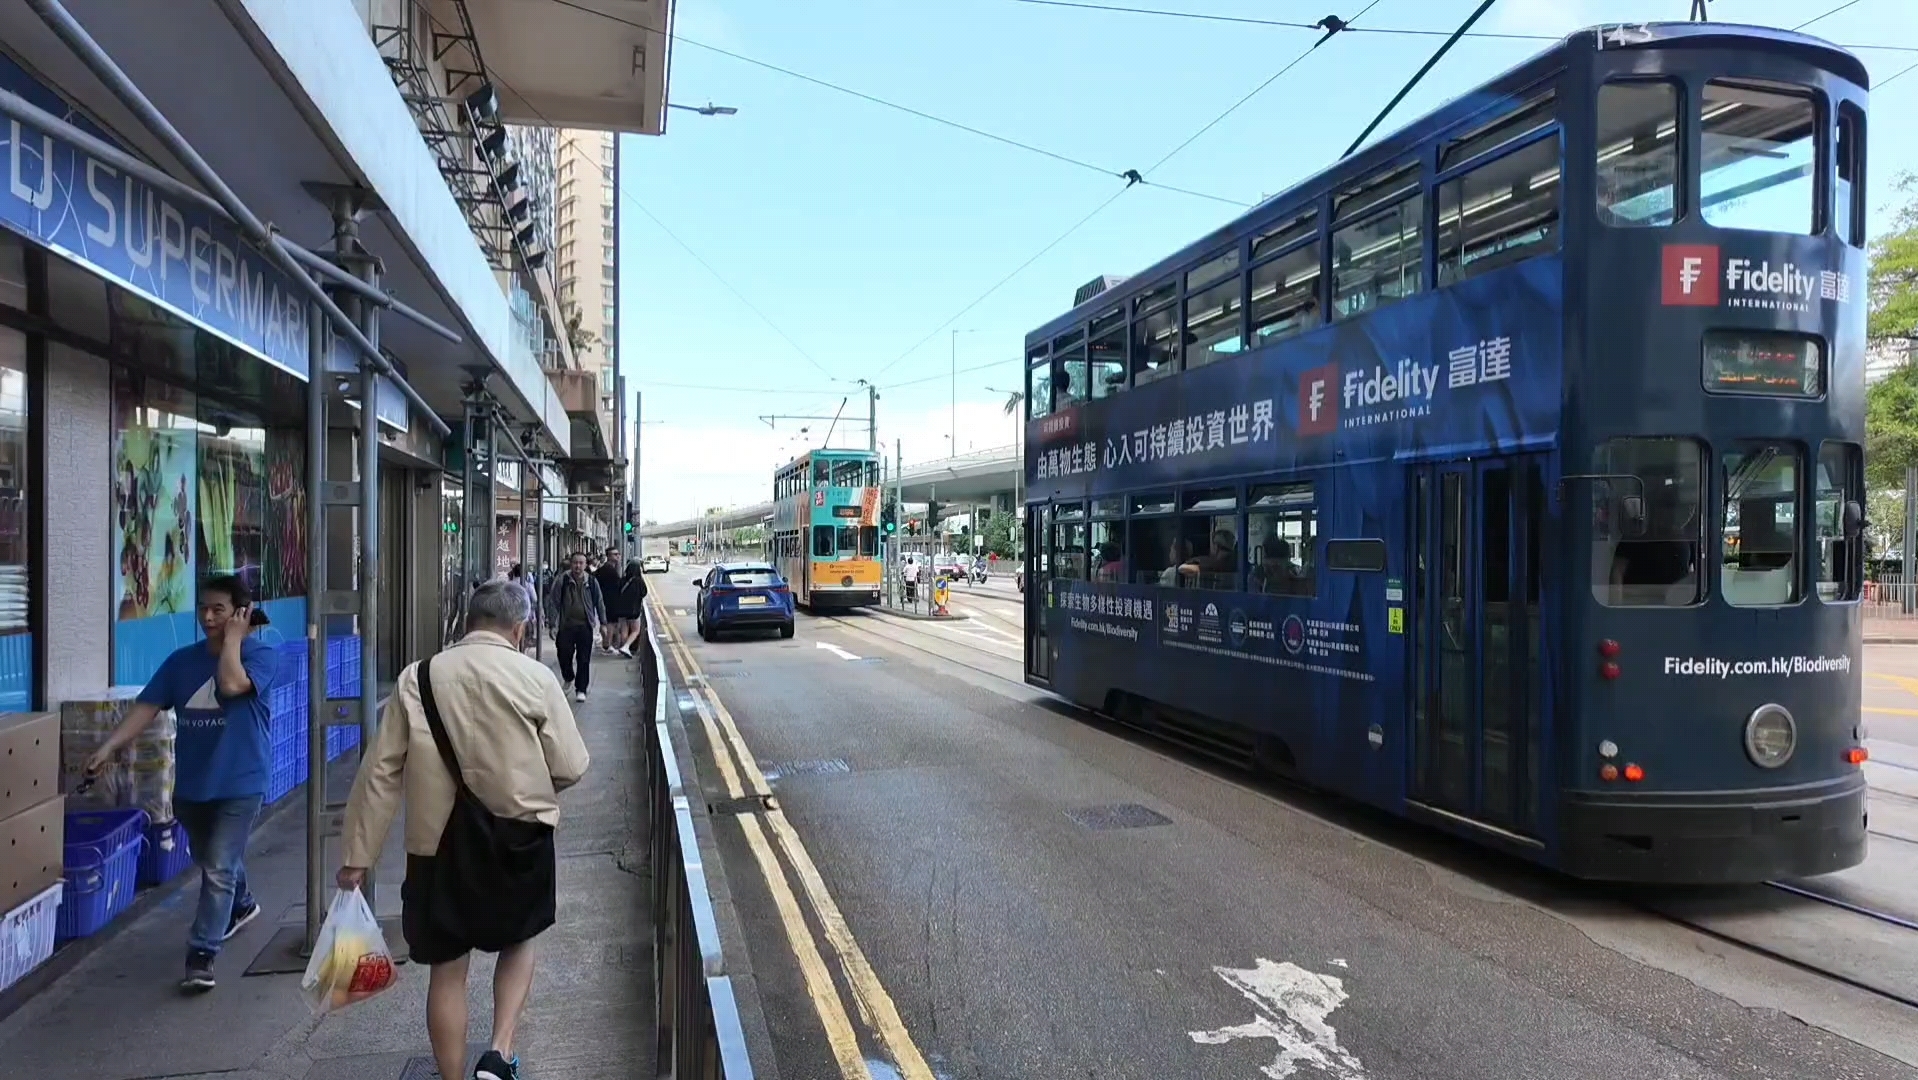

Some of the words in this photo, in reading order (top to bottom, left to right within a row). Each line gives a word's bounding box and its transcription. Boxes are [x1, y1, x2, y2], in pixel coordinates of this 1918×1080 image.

[86, 157, 309, 355] SUPERMAR
[1726, 258, 1815, 300] Fidelity
[1820, 270, 1850, 304] 富達
[1728, 297, 1809, 313] INTERNATIONAL
[1343, 357, 1440, 410] Fidelity
[1448, 336, 1512, 389] 富達
[1344, 405, 1431, 429] INTERNATIONAL
[1037, 441, 1097, 480] 由萬物生態
[1103, 399, 1274, 469] 心入可持續投資世界
[1060, 591, 1153, 621] 探索生物多樣性投資機遇
[1070, 616, 1139, 642] Fidelity.com.hk/Biodiversity
[1664, 654, 1851, 679] Fidelity.com.hk/Biodiversity
